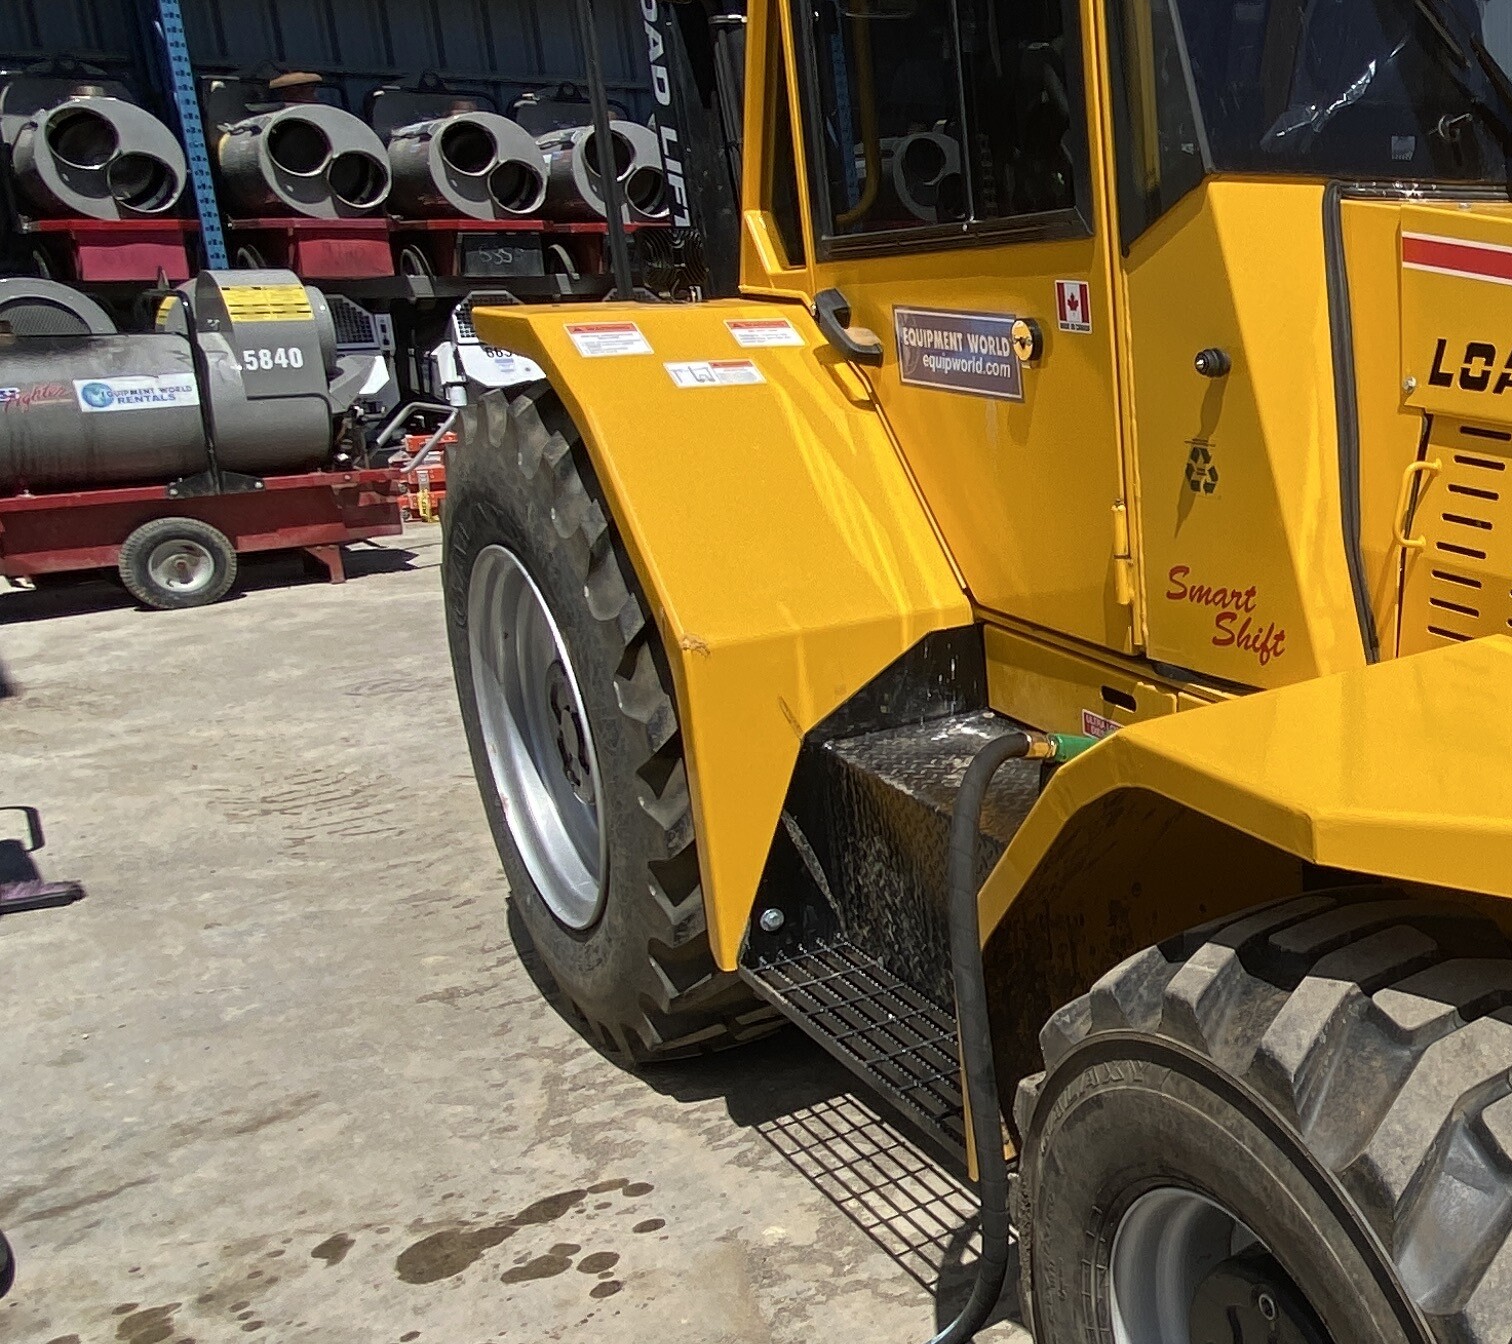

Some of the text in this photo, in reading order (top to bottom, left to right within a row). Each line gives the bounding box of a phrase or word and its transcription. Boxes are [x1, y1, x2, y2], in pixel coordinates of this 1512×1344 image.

[902, 326, 1011, 357] EQUIPMENT WORLD
[243, 347, 304, 371] 5840
[922, 352, 1011, 378] equipworld.com
[117, 393, 176, 404] RENTALS
[159, 385, 192, 394] WORLD
[1166, 565, 1258, 613] Smart
[1211, 611, 1286, 667] Shift
